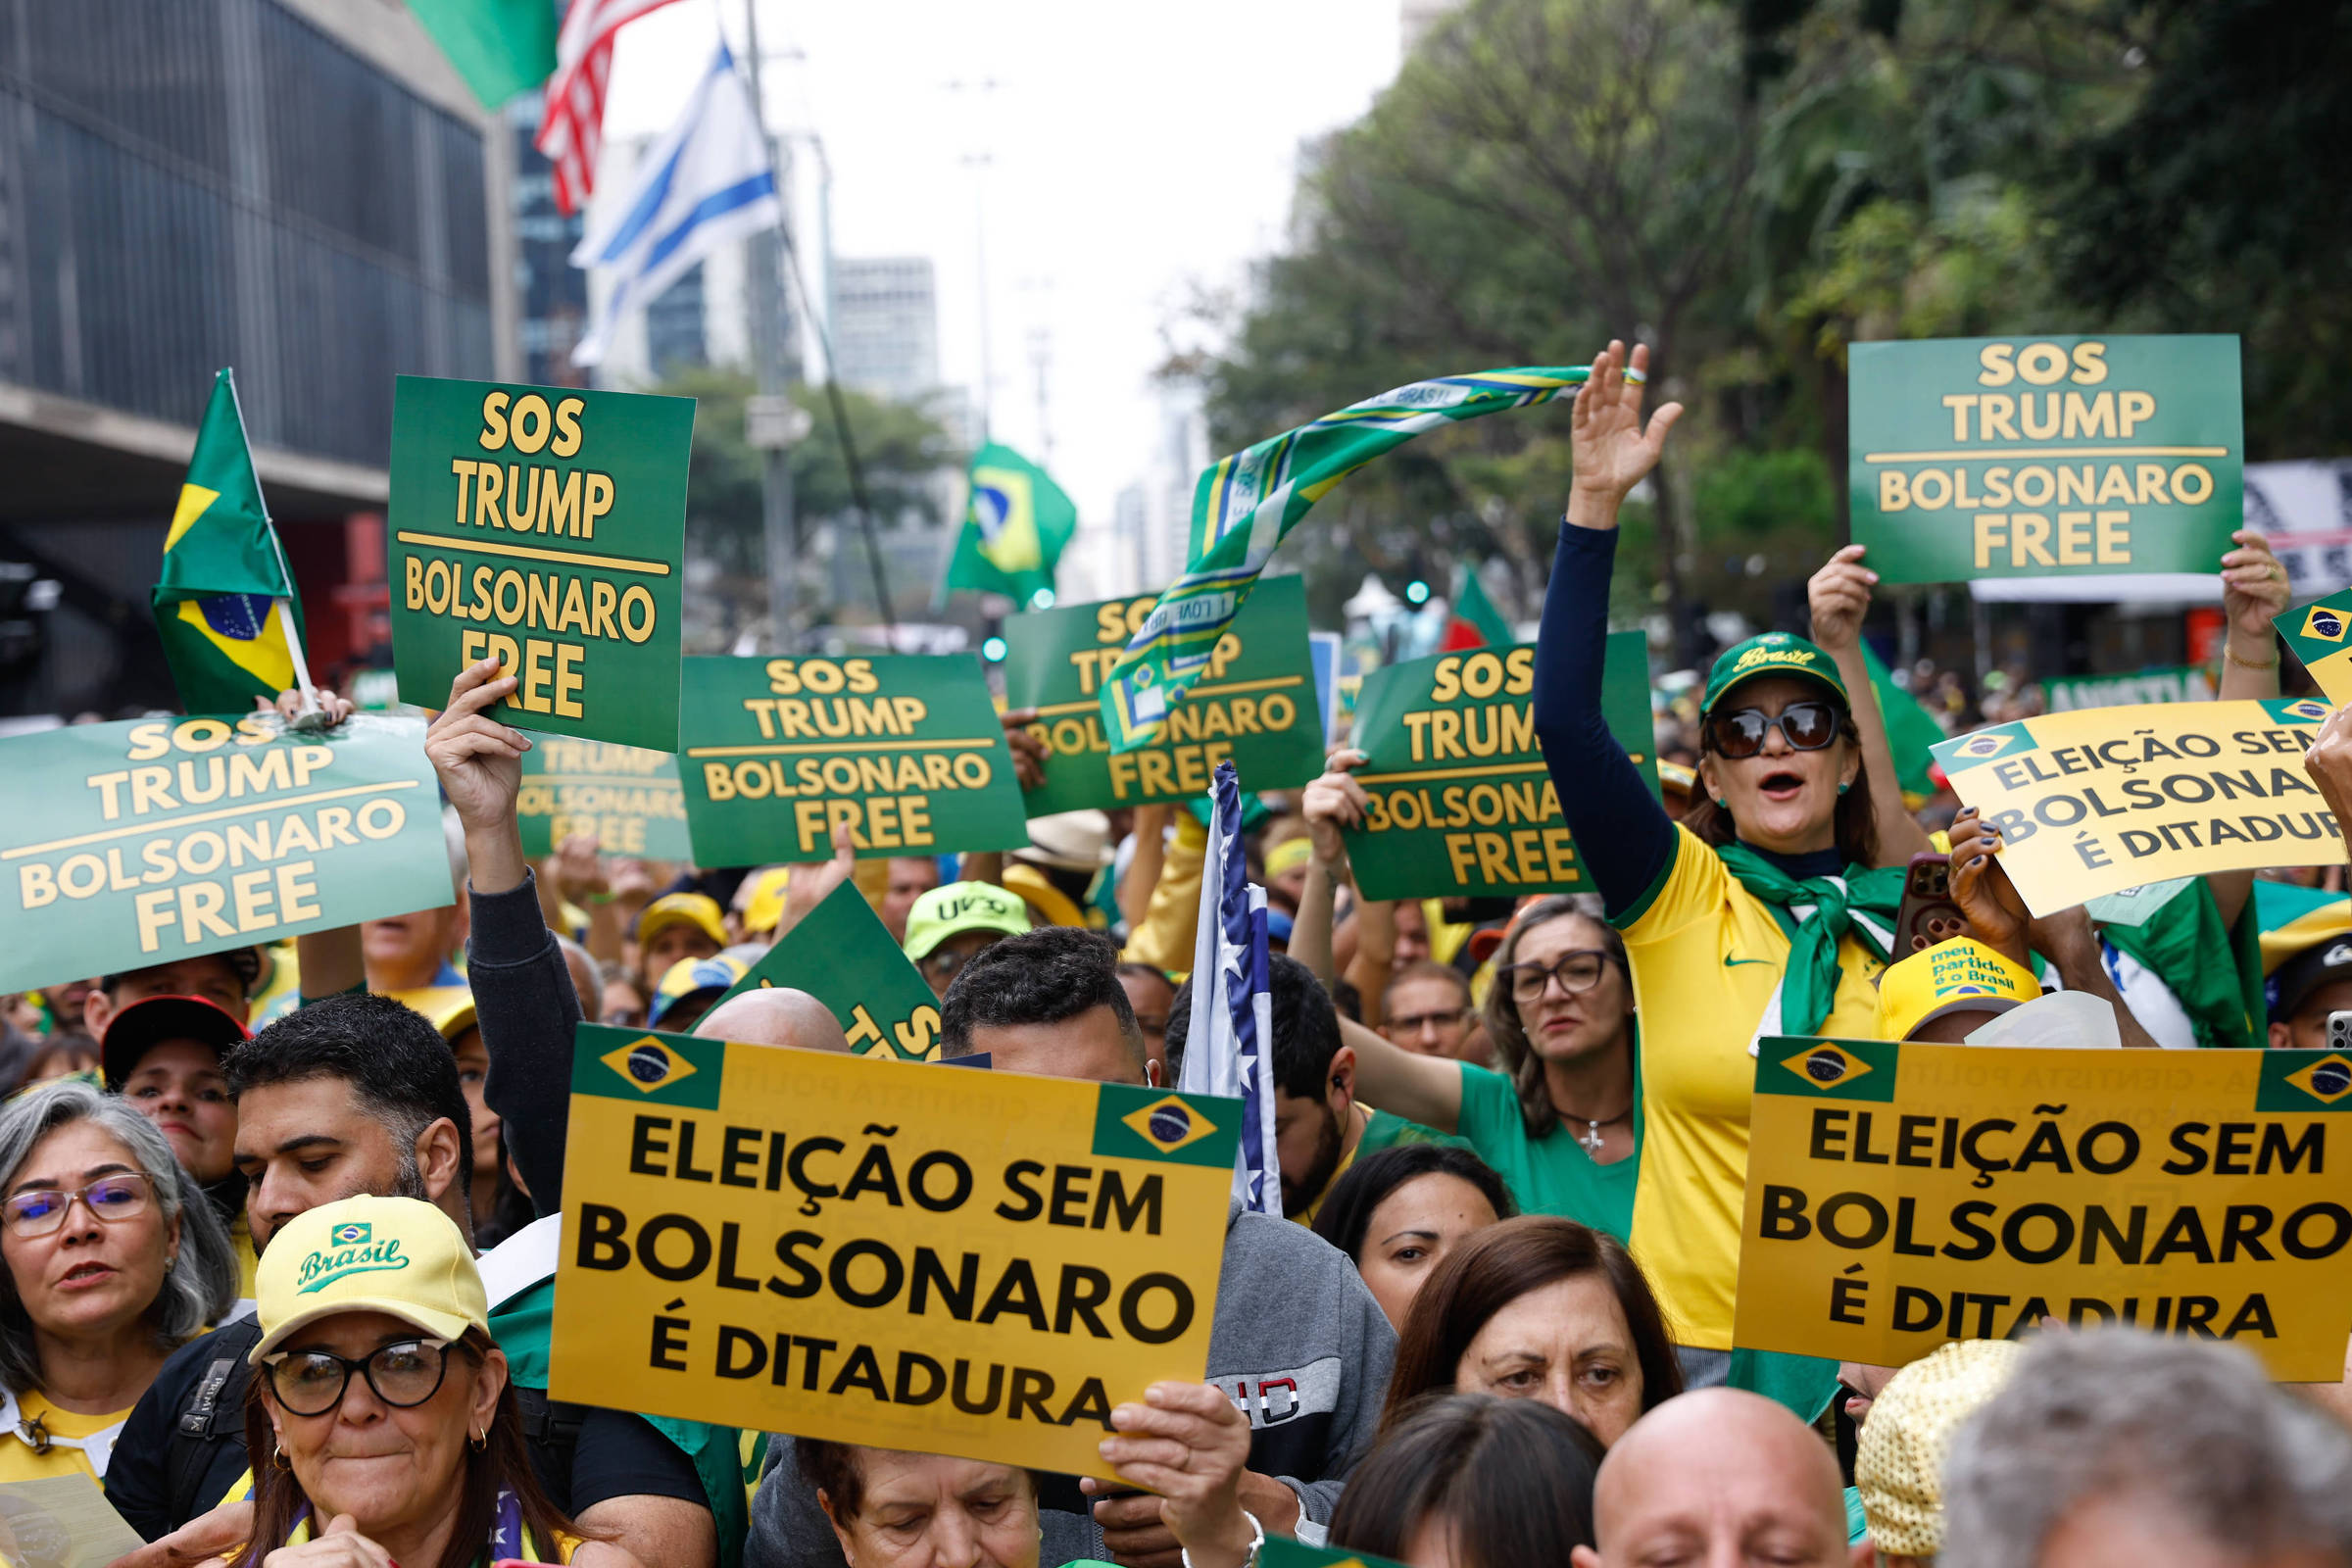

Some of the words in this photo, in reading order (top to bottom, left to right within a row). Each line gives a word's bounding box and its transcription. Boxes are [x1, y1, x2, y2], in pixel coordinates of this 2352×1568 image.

[1977, 342, 2108, 387] SOS
[479, 391, 585, 458] SOS
[1942, 391, 2156, 442] TRUMP
[452, 459, 614, 539] TRUMP
[1880, 463, 2214, 513] BOLSONARO
[1973, 511, 2132, 569] FREE
[405, 556, 657, 645] BOLSONARO
[764, 659, 880, 694] SOS
[1431, 648, 1535, 703] SOS
[126, 716, 277, 760] SOS
[743, 696, 928, 739] TRUMP
[1402, 702, 1542, 762] TRUM
[87, 745, 335, 821] TRUMP
[541, 740, 670, 775] TRUMP
[703, 754, 992, 802] BOLSONARO
[1992, 729, 2221, 793] ELEIÇÃO
[794, 795, 933, 853] FREE
[1366, 779, 1564, 832] BOLSONA
[1990, 766, 2321, 847] BOLSONA
[19, 798, 406, 910] BOLSONARO
[1445, 827, 1581, 886] FREE
[2074, 831, 2113, 870] É
[2118, 810, 2342, 859] DITADUR
[133, 859, 321, 954] FREE
[1931, 947, 1975, 963] meu
[1933, 957, 2006, 977] partido
[1968, 970, 2016, 991] Brasil
[1809, 1103, 2140, 1189] ELEIÇÃO
[2162, 1122, 2327, 1176] SEM
[630, 1114, 973, 1216] ELEIÇÃO
[994, 1160, 1164, 1237] SEM
[1759, 1184, 2352, 1266] BOLSONARO
[296, 1238, 410, 1296] Brasil
[575, 1202, 1195, 1346] BOLSONARO
[1829, 1261, 1870, 1324] É
[649, 1297, 691, 1372] É
[714, 1326, 1117, 1433] DITADURA
[190, 1376, 224, 1431] PRIMIIA
